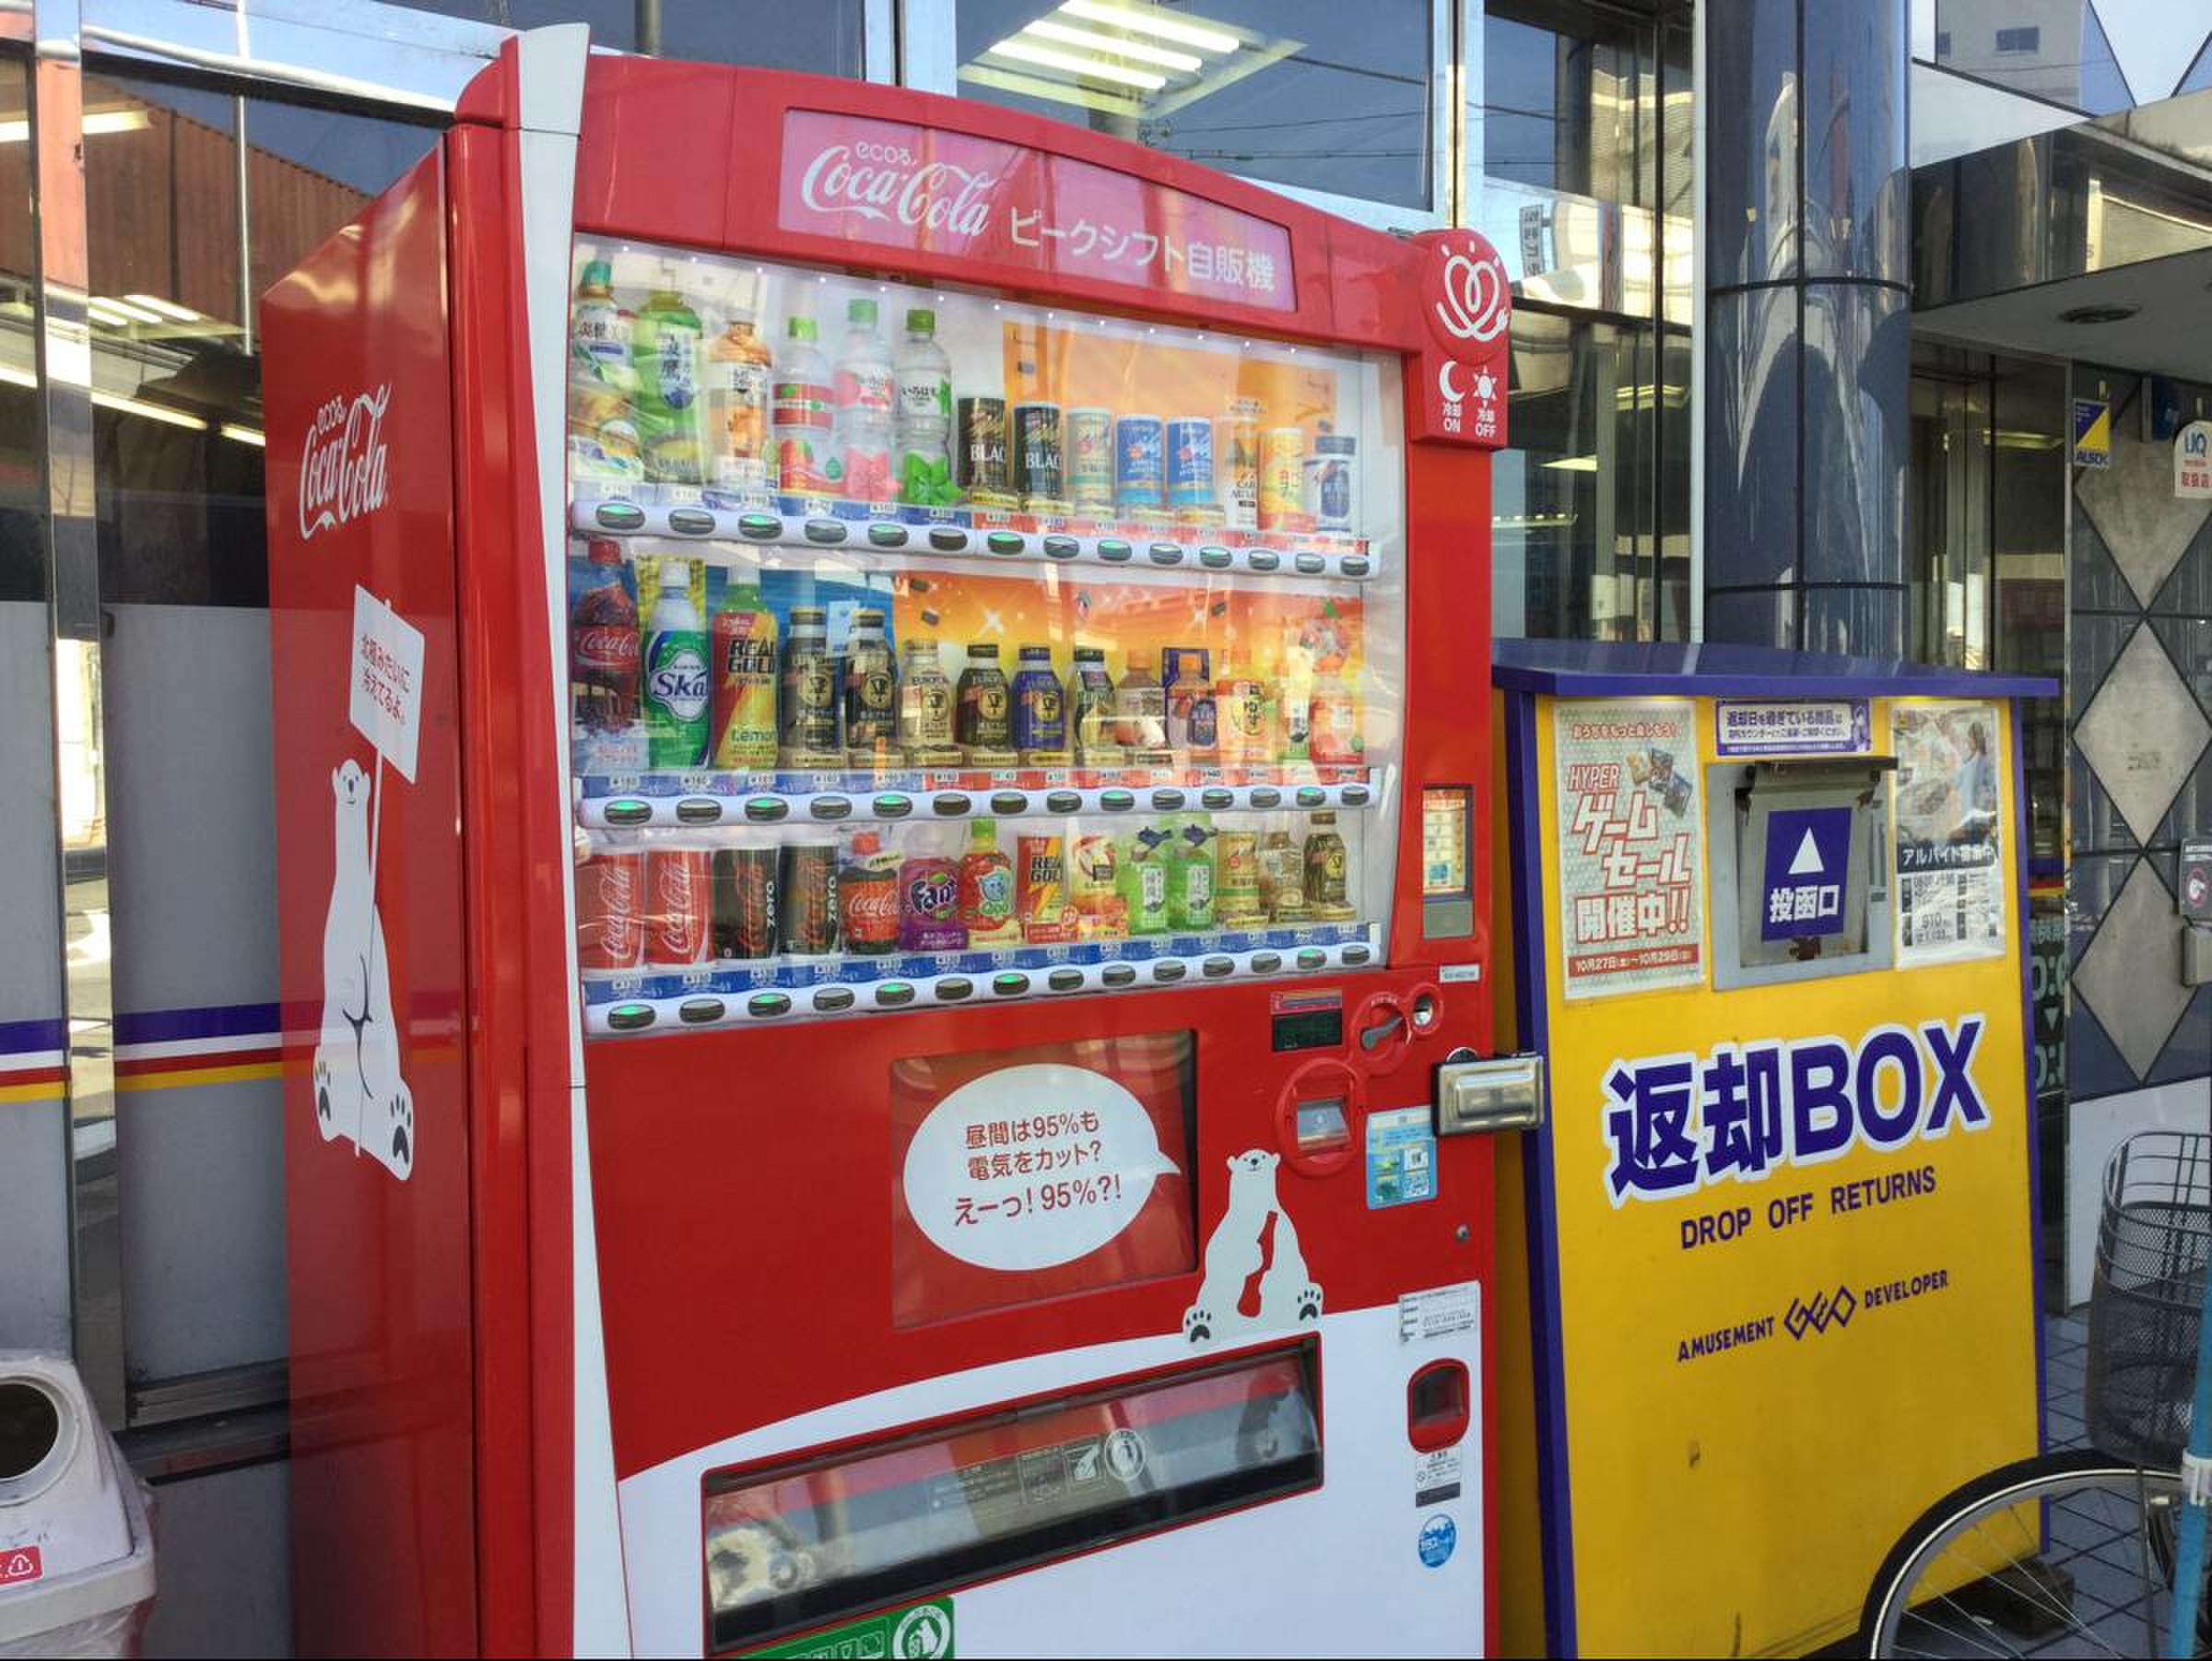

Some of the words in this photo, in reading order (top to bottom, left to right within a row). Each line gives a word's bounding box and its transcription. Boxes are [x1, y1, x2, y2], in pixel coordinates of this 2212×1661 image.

[802, 146, 998, 237] Coca-Cola
[1010, 206, 1276, 292] ピークシフト自販機
[1443, 418, 1461, 432] ON
[1475, 422, 1496, 438] OFF
[2185, 431, 2207, 458] UQ
[299, 382, 393, 540] Coca-Cola
[1568, 763, 1621, 792] HYPER
[1571, 790, 1659, 855] ゲーム
[1603, 832, 1692, 889] セール
[1575, 886, 1692, 945] 開催中!!
[1769, 884, 1841, 924] 投函口
[964, 1110, 1100, 1150] 昼間は95%も
[1607, 1019, 1987, 1199] 返却BOX
[967, 1140, 1102, 1181] 電気をカット?
[1680, 1207, 1752, 1250] DROP
[1768, 1193, 1814, 1229] OFF
[1830, 1165, 1936, 1215] RETURNS
[1677, 1315, 1775, 1363] AMUSEMENT
[1864, 1268, 1948, 1309] DEVELOPER
